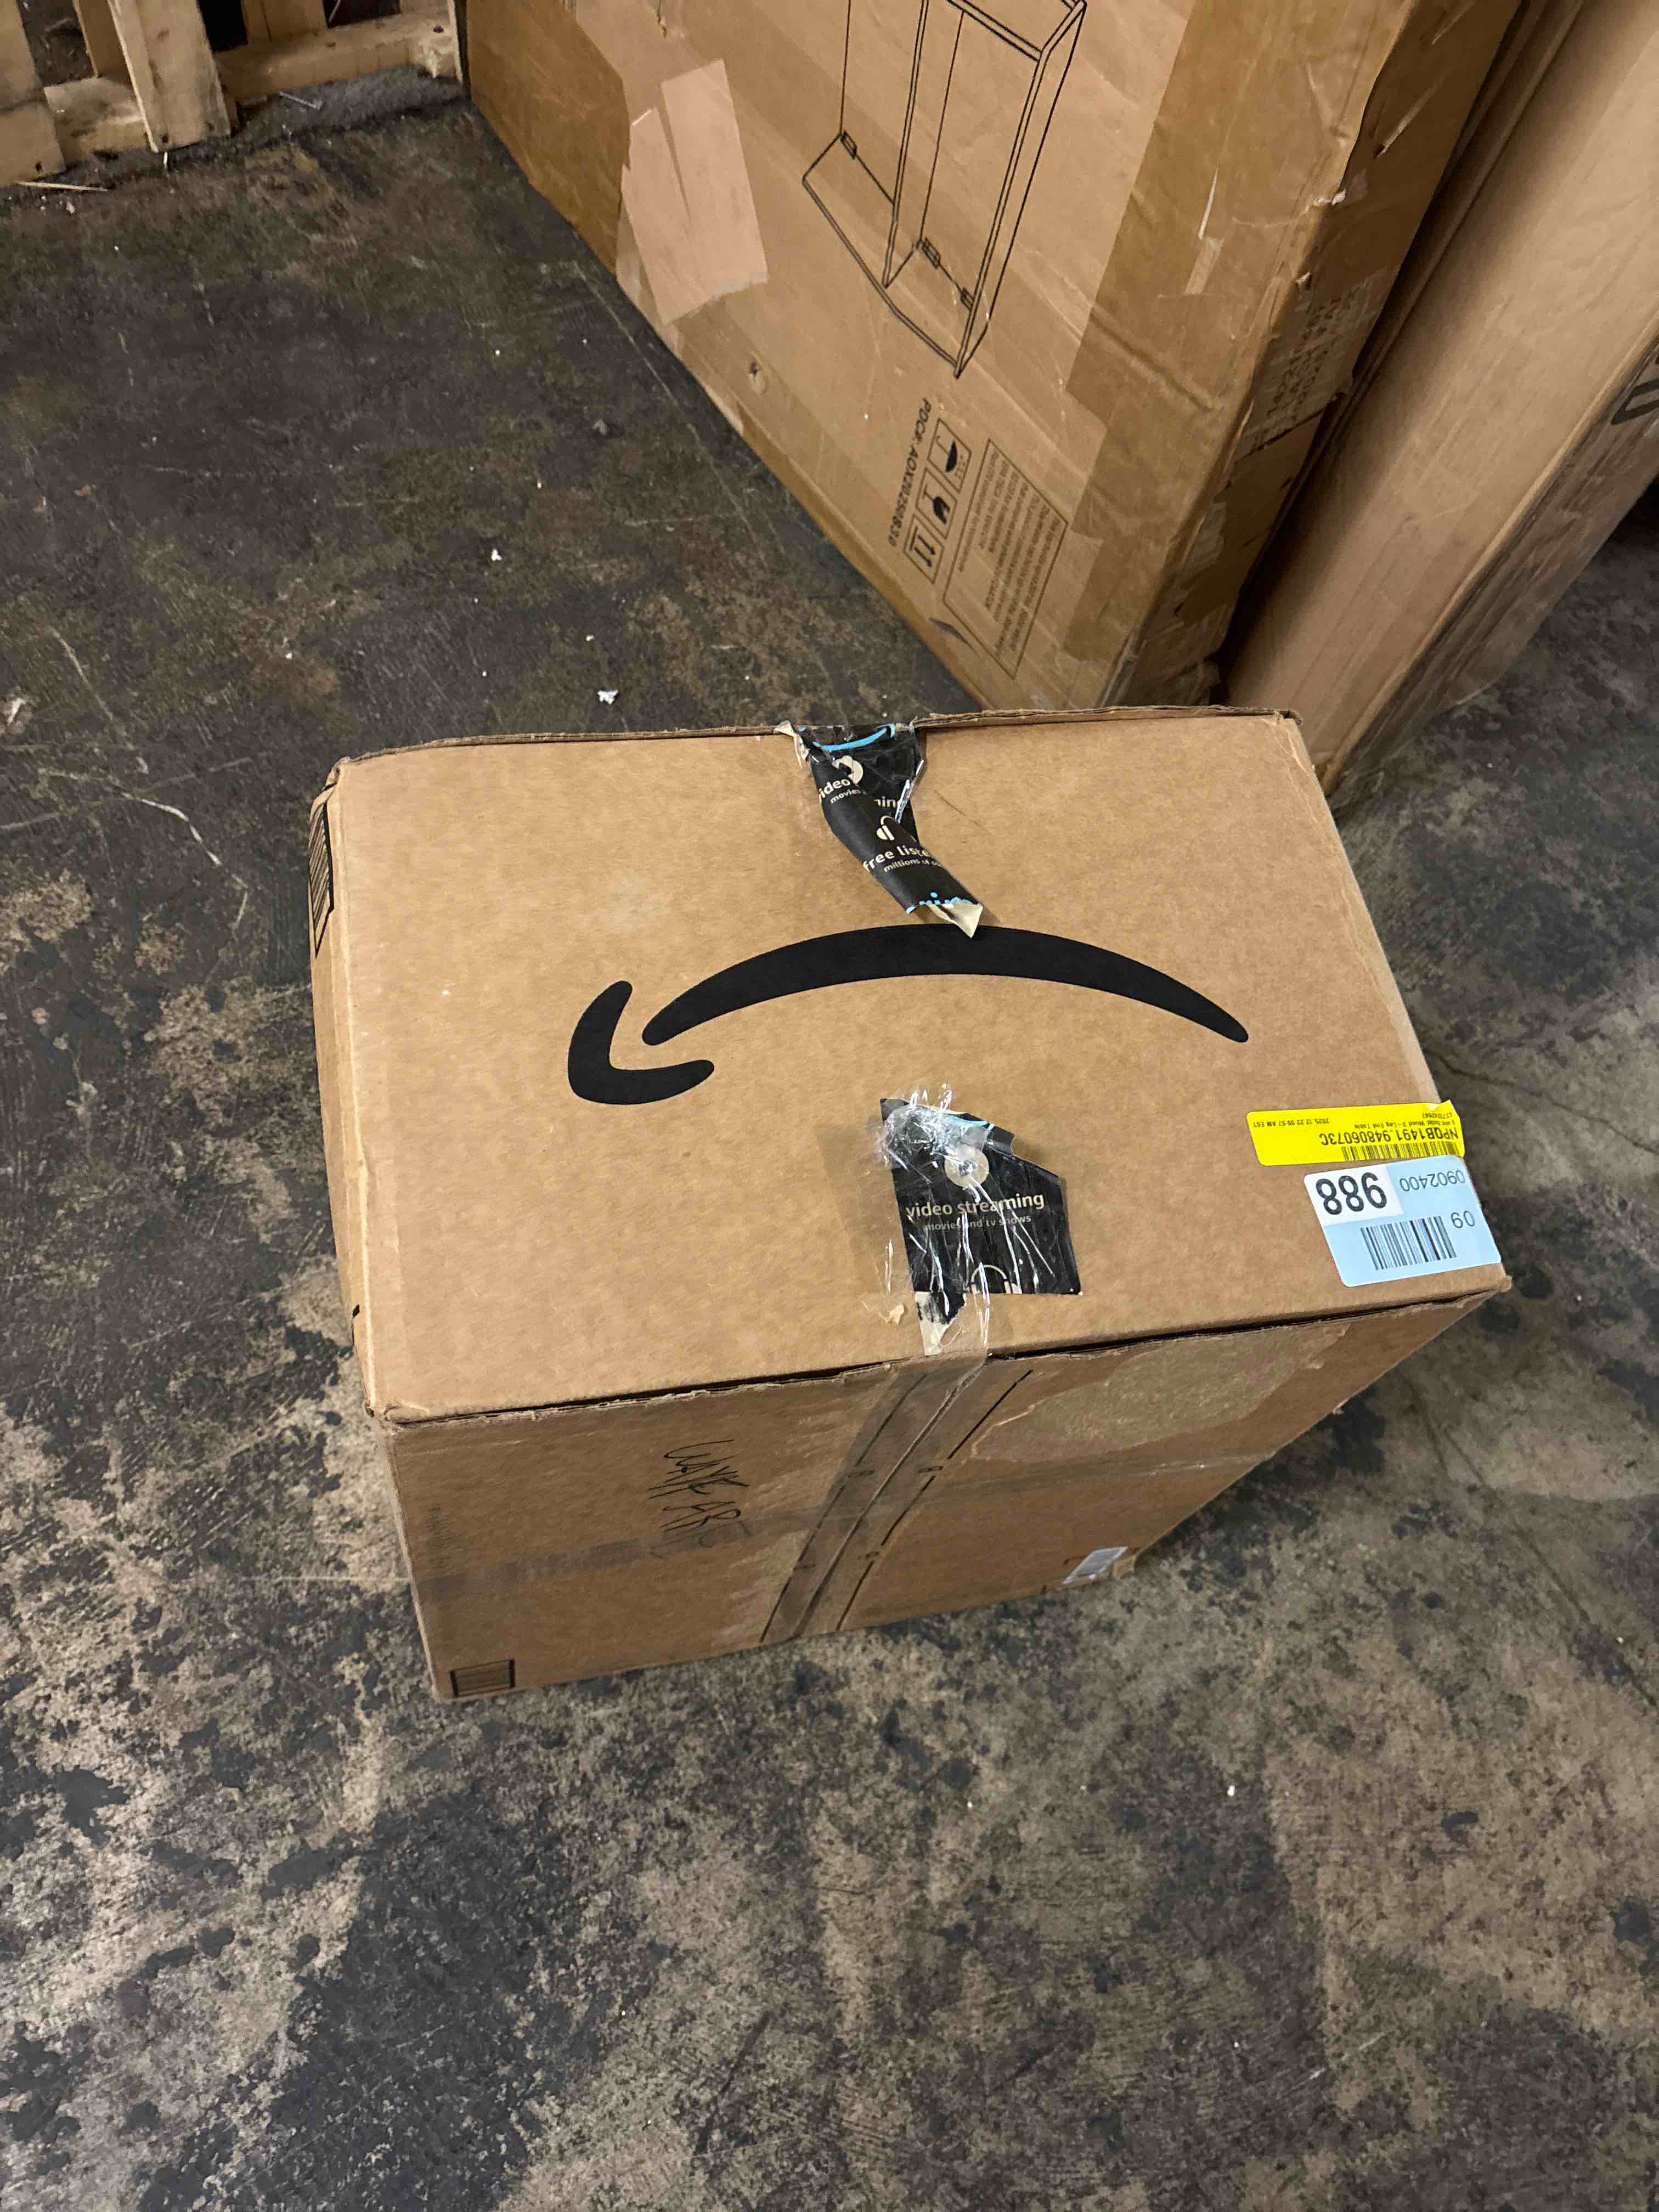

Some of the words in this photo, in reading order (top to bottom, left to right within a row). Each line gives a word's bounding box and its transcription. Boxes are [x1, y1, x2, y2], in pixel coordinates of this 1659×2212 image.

[863, 849, 894, 873] free
[883, 857, 921, 872] millions
[1399, 1170, 1466, 1192] 0902400
[905, 1201, 953, 1217] video
[958, 1192, 1045, 1215] streaming
[1315, 1172, 1387, 1215] 988
[1450, 1211, 1475, 1229] 09
